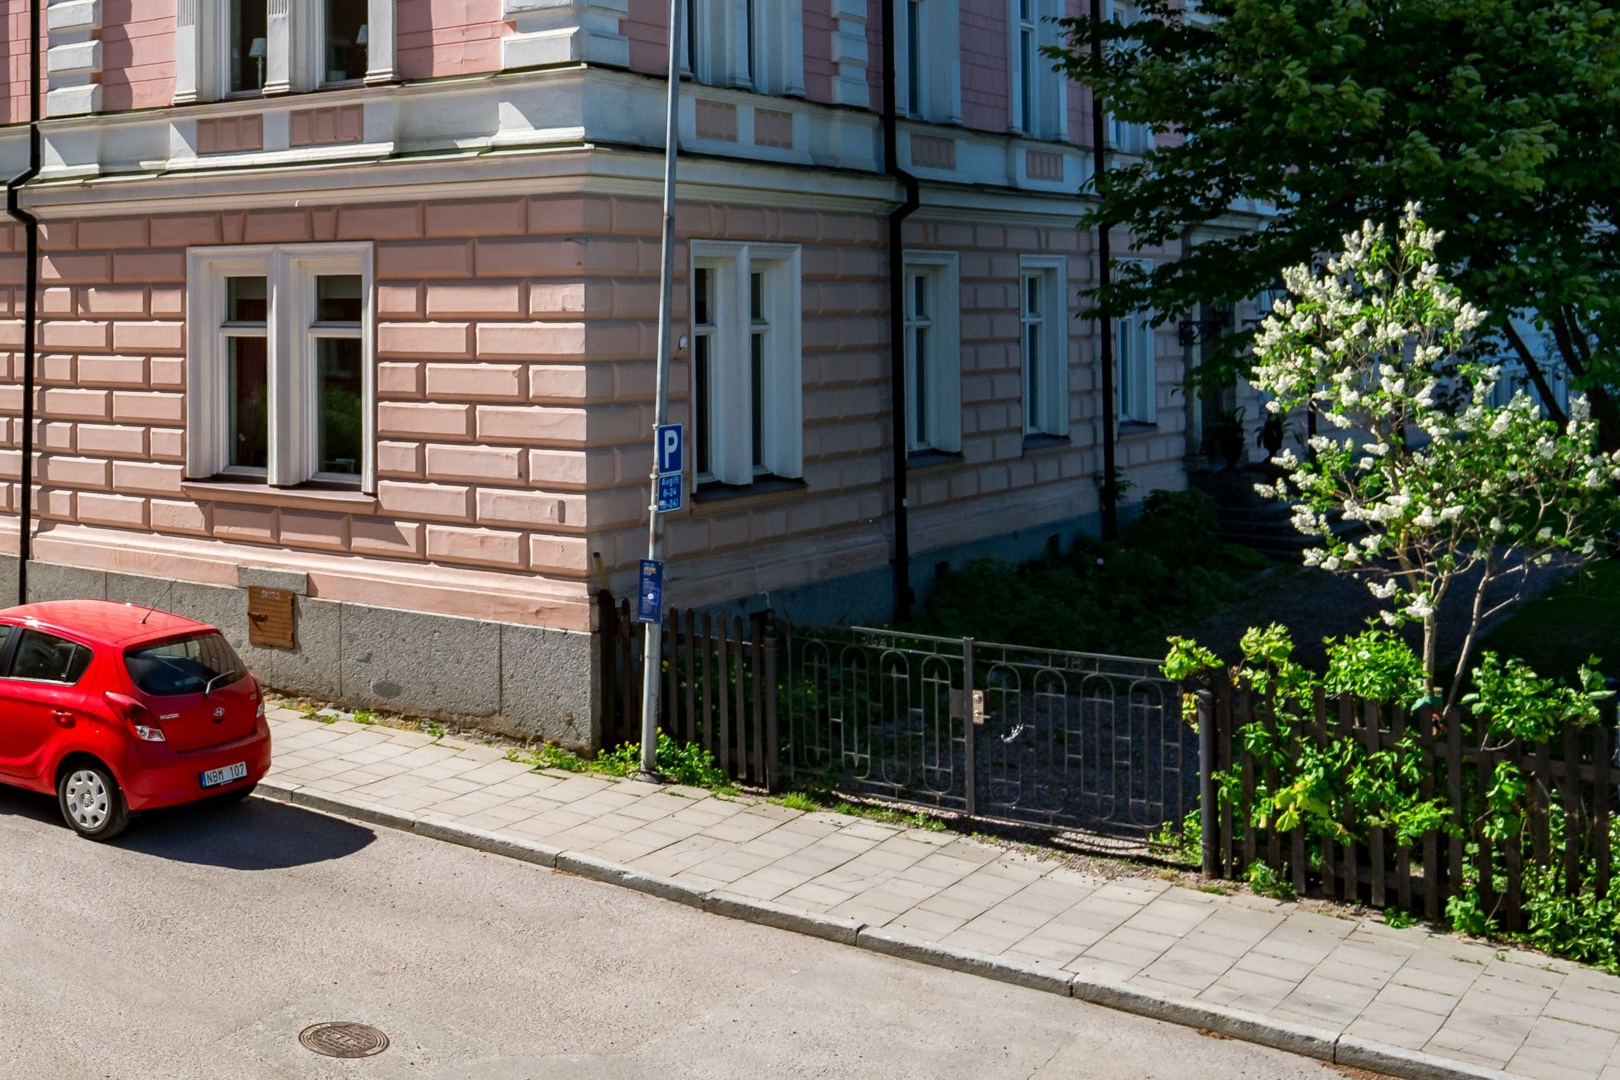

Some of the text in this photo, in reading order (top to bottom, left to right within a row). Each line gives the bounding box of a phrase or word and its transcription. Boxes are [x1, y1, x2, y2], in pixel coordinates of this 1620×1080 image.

[664, 429, 678, 469] P
[661, 476, 679, 487] Avgift
[206, 770, 225, 783] NBM
[229, 763, 244, 777] 107
